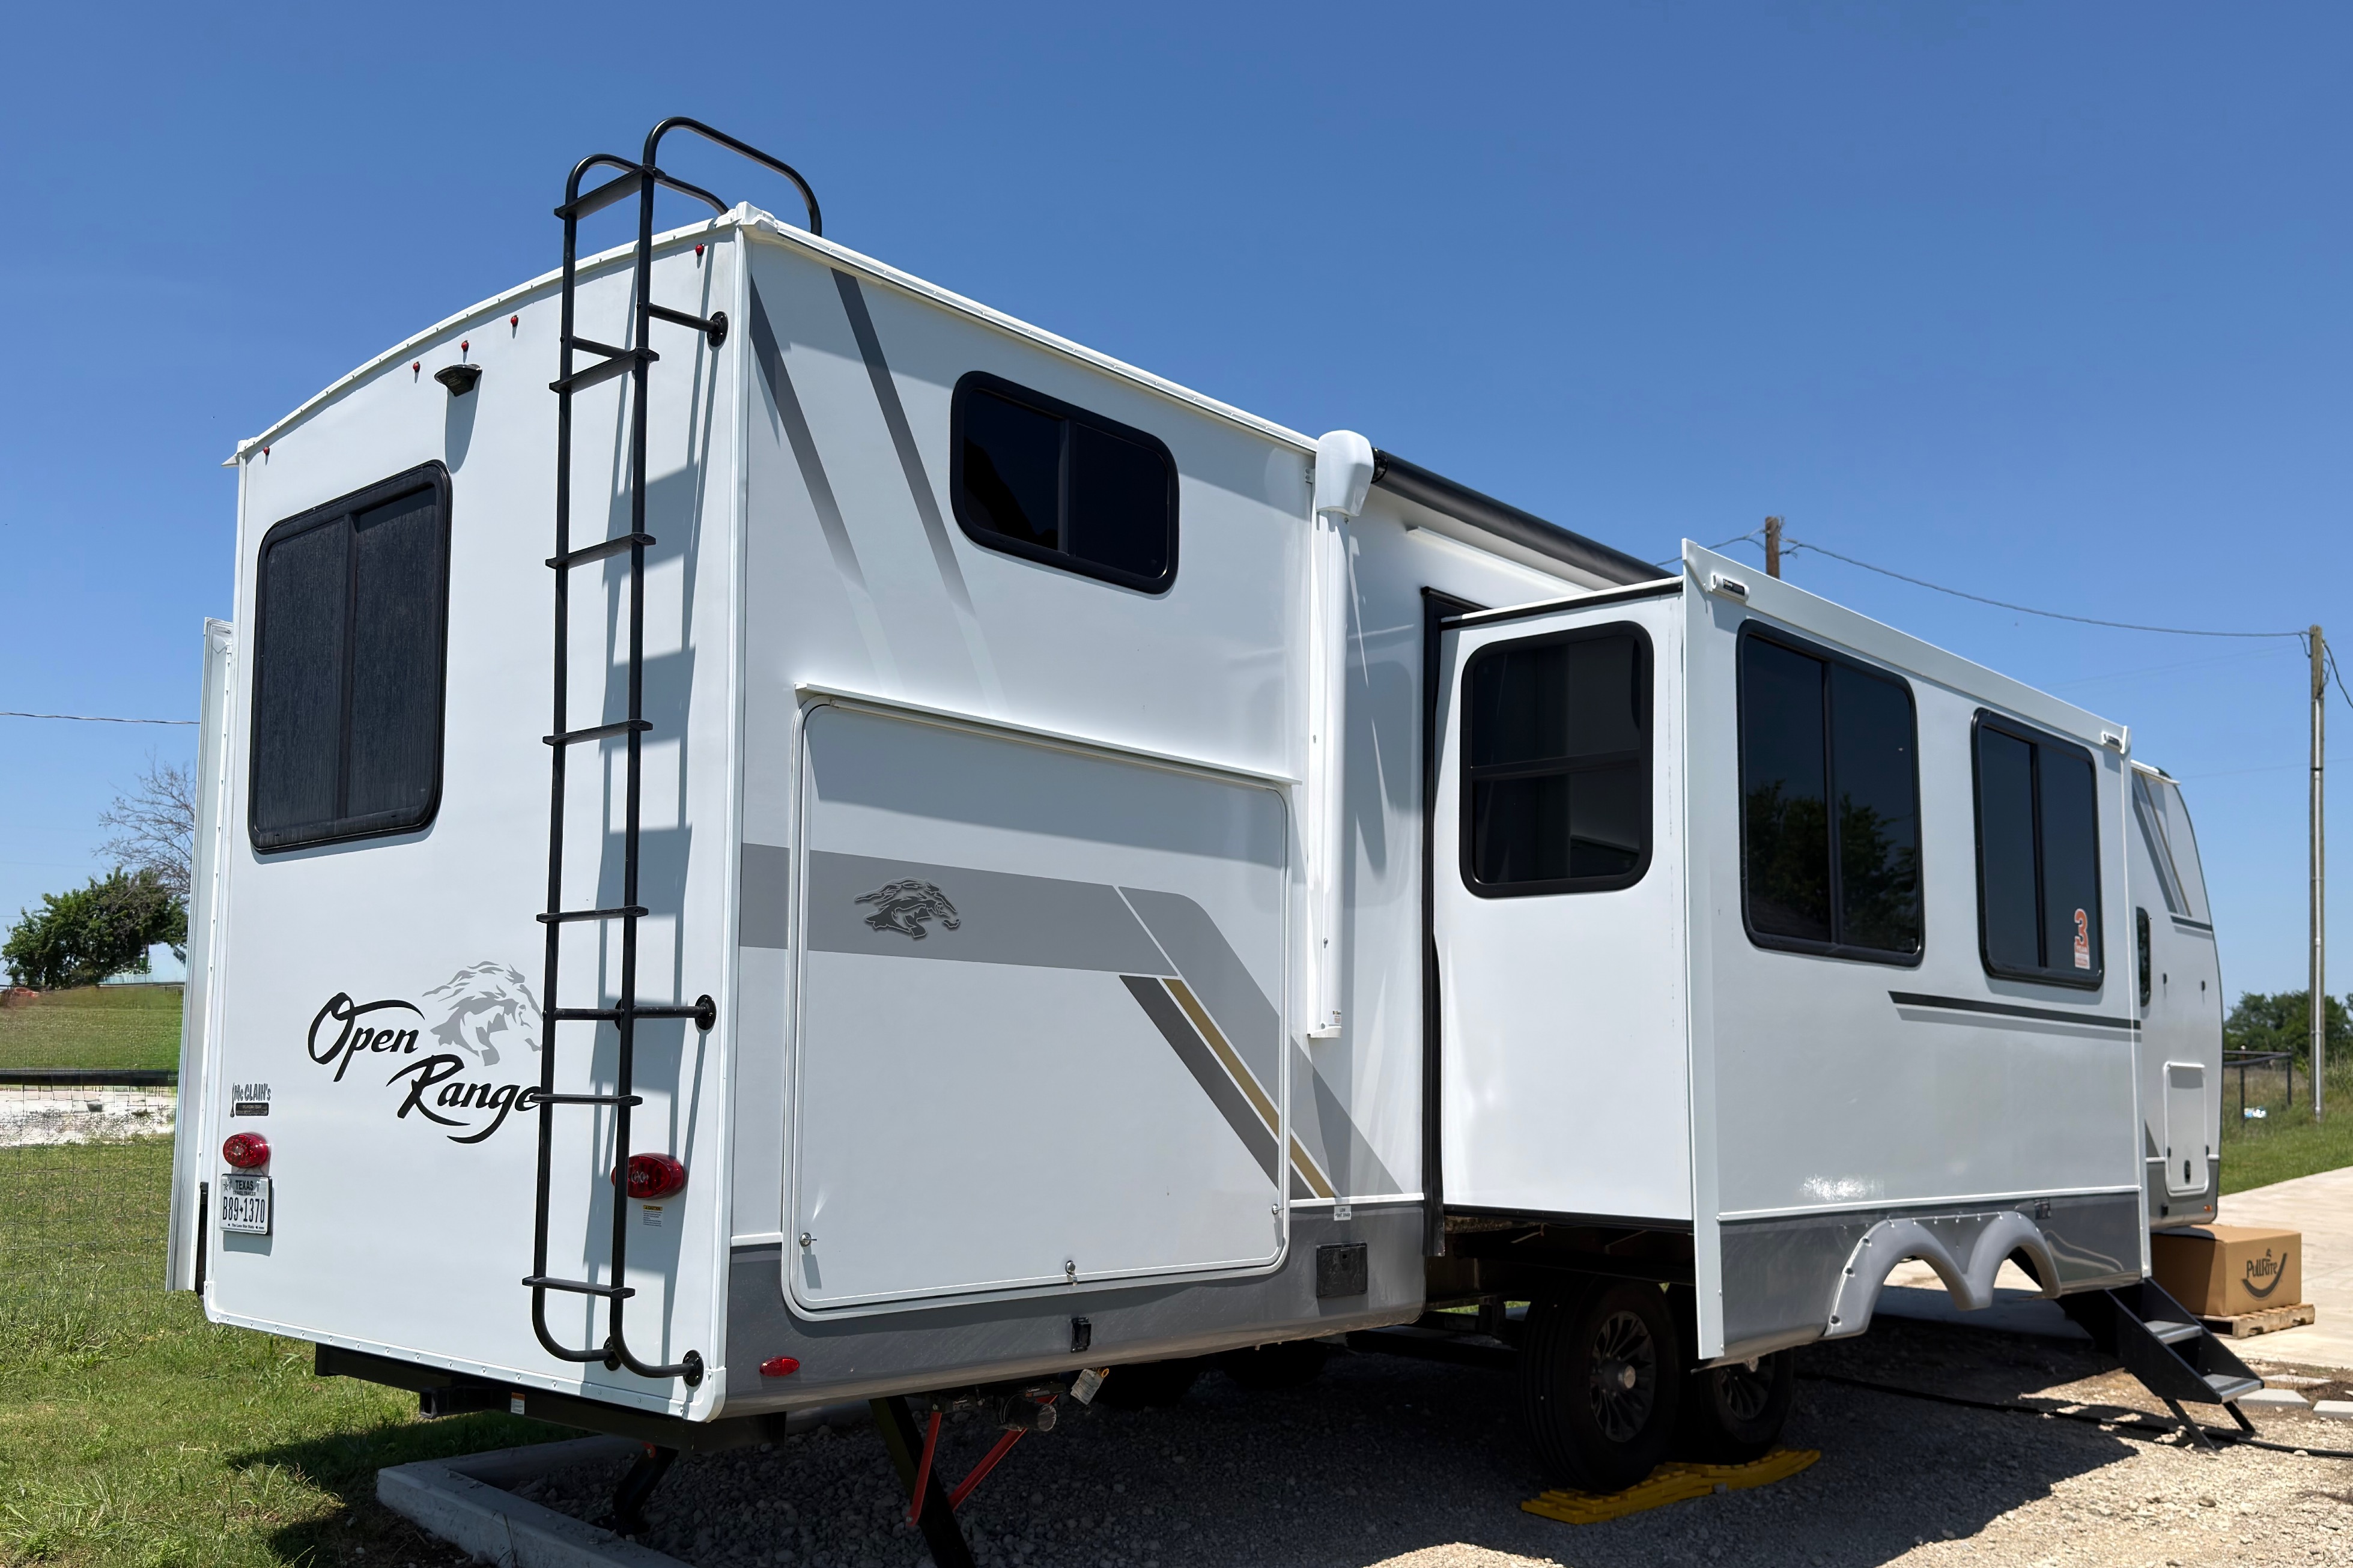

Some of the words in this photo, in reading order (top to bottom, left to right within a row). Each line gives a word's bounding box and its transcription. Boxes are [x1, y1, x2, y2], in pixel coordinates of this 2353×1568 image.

[2075, 909, 2088, 946] 3
[308, 991, 425, 1082] Open
[386, 1053, 541, 1143] Range
[235, 1179, 254, 1191] TEXAS
